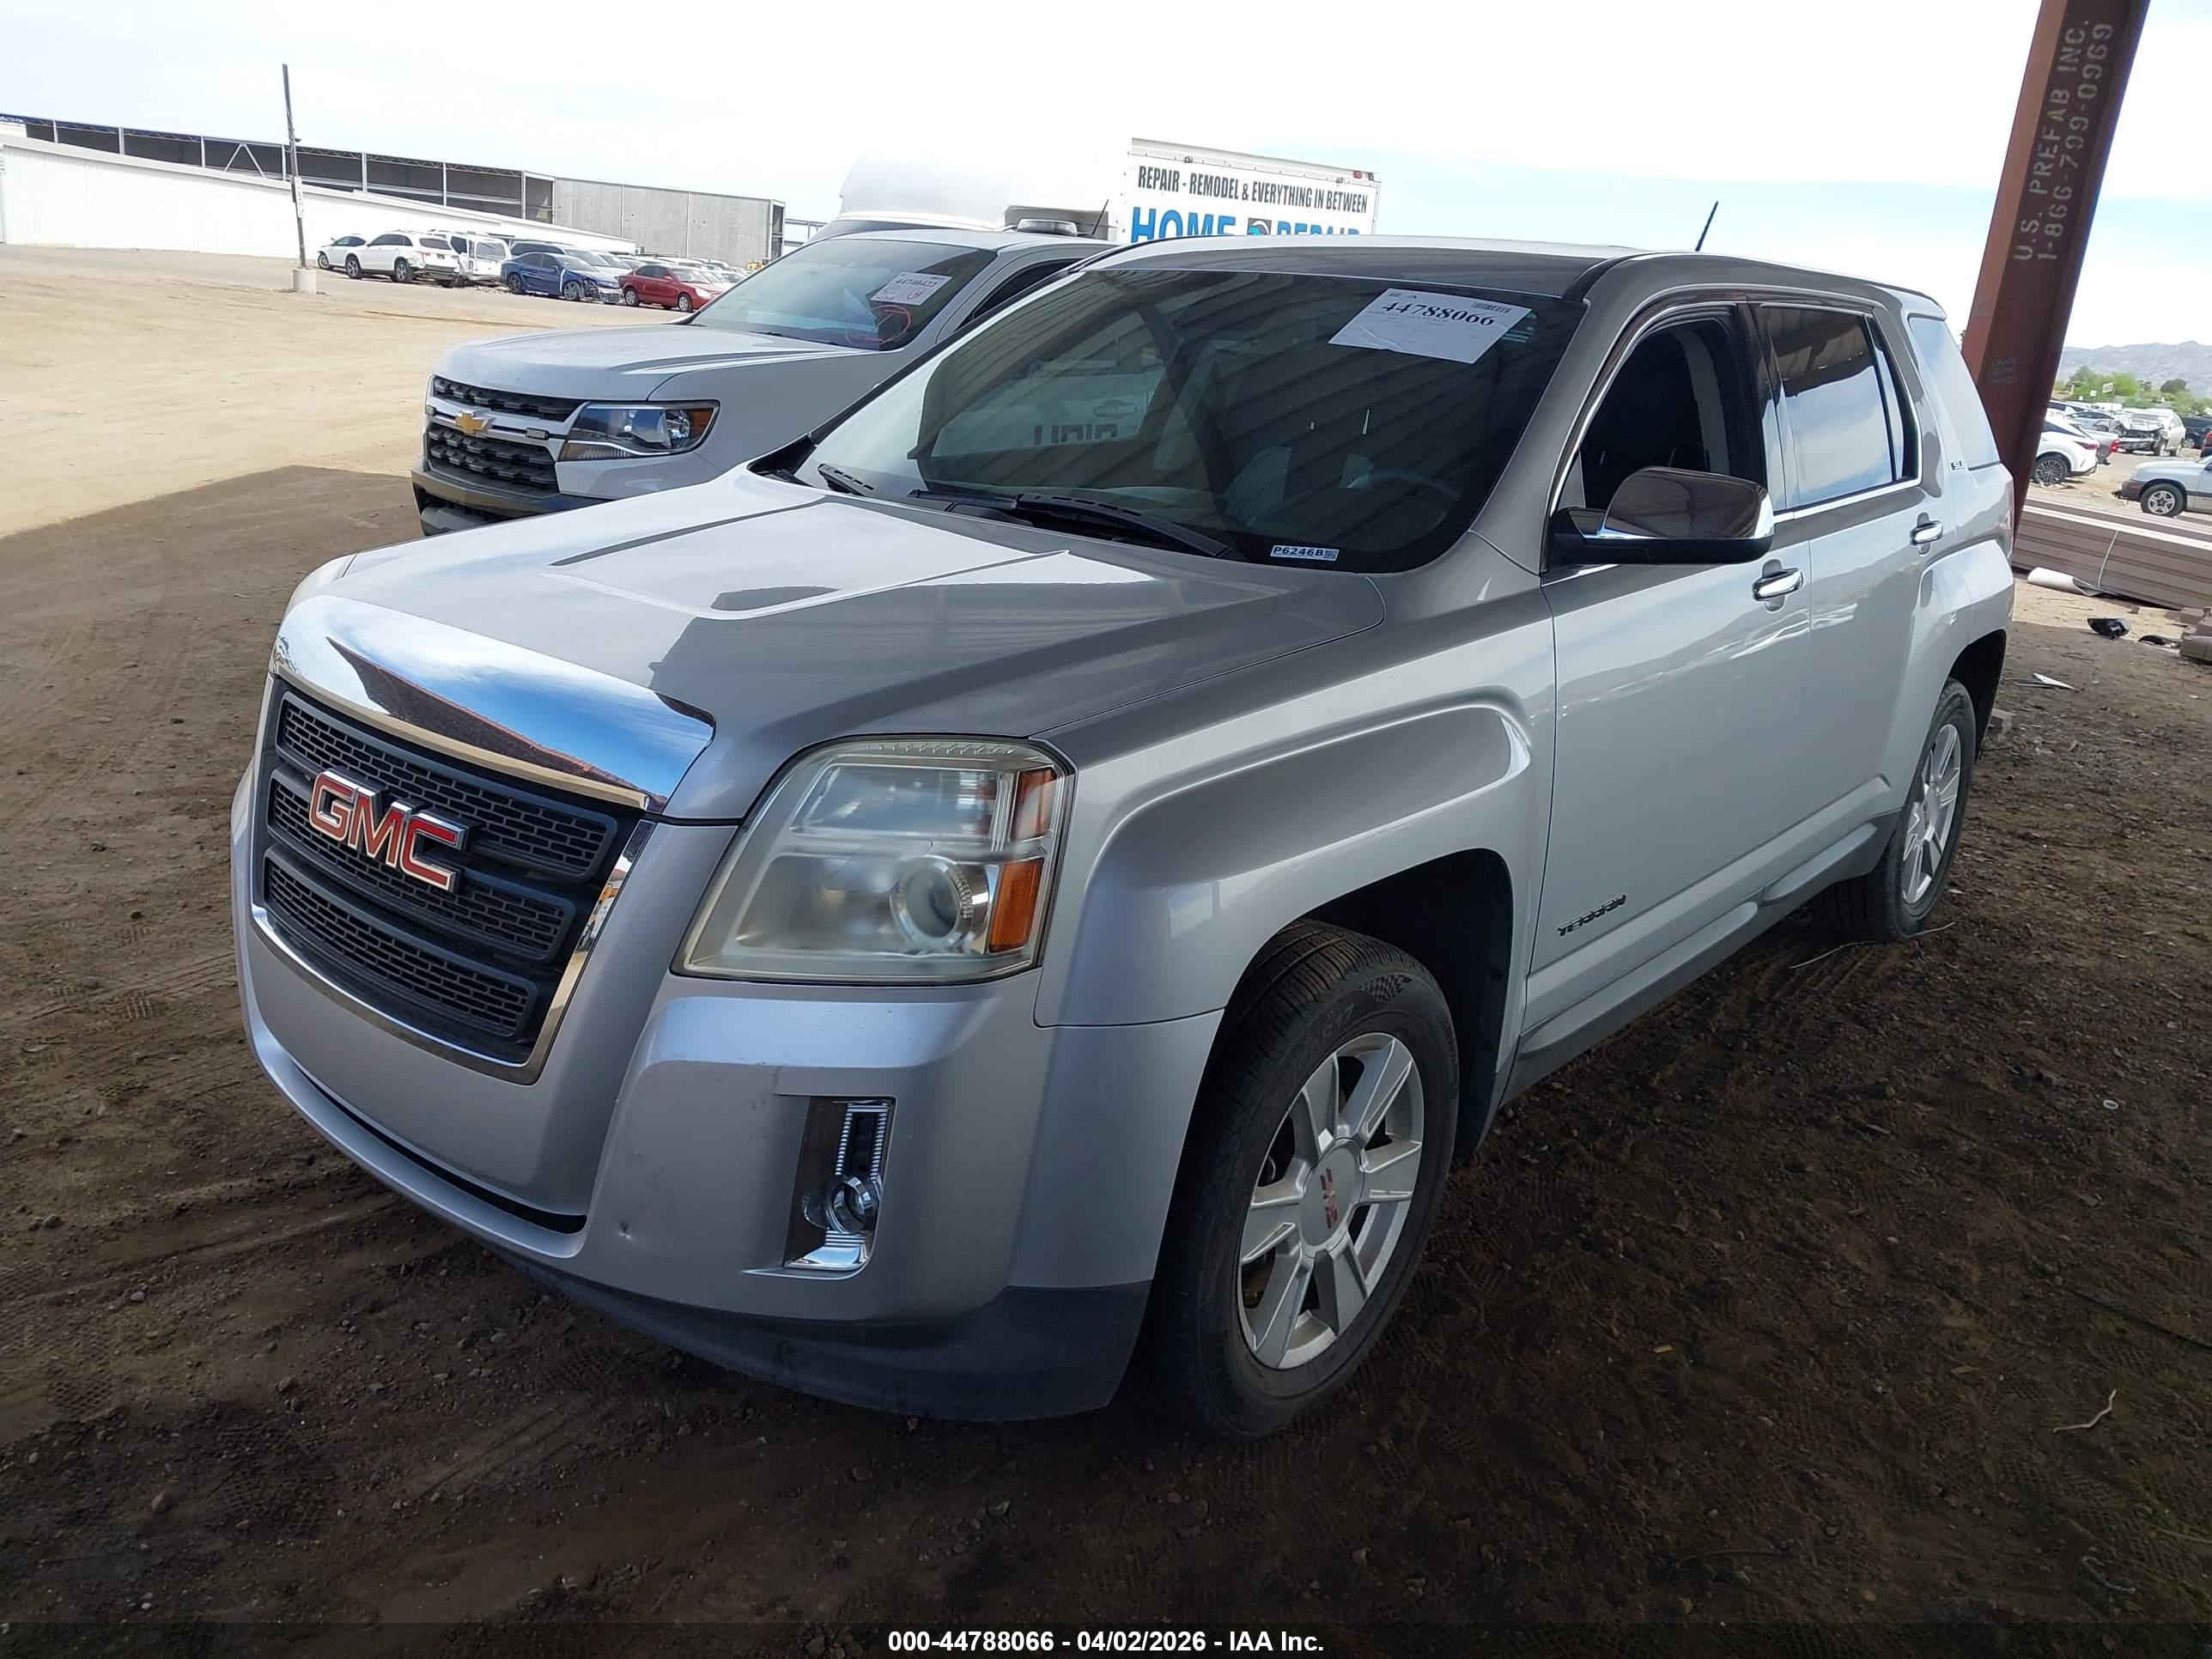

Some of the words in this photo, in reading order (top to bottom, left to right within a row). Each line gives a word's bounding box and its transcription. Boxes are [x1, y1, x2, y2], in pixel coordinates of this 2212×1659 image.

[2013, 211, 2043, 261] U.S.
[2028, 88, 2070, 195] PREFAB
[2057, 20, 2089, 72] INC.
[2038, 23, 2113, 261] 1-866-799-0969
[1138, 166, 1180, 192] REPAIR
[1188, 172, 1239, 200] REMODEL
[1242, 183, 1249, 202] &
[1251, 180, 1312, 210] EVERYTHING
[1314, 188, 1324, 210] IN
[1327, 190, 1368, 214] BETWEEN
[1382, 301, 1496, 326] 44788066
[1273, 547, 1323, 556] P6246B
[309, 770, 467, 893] GMC
